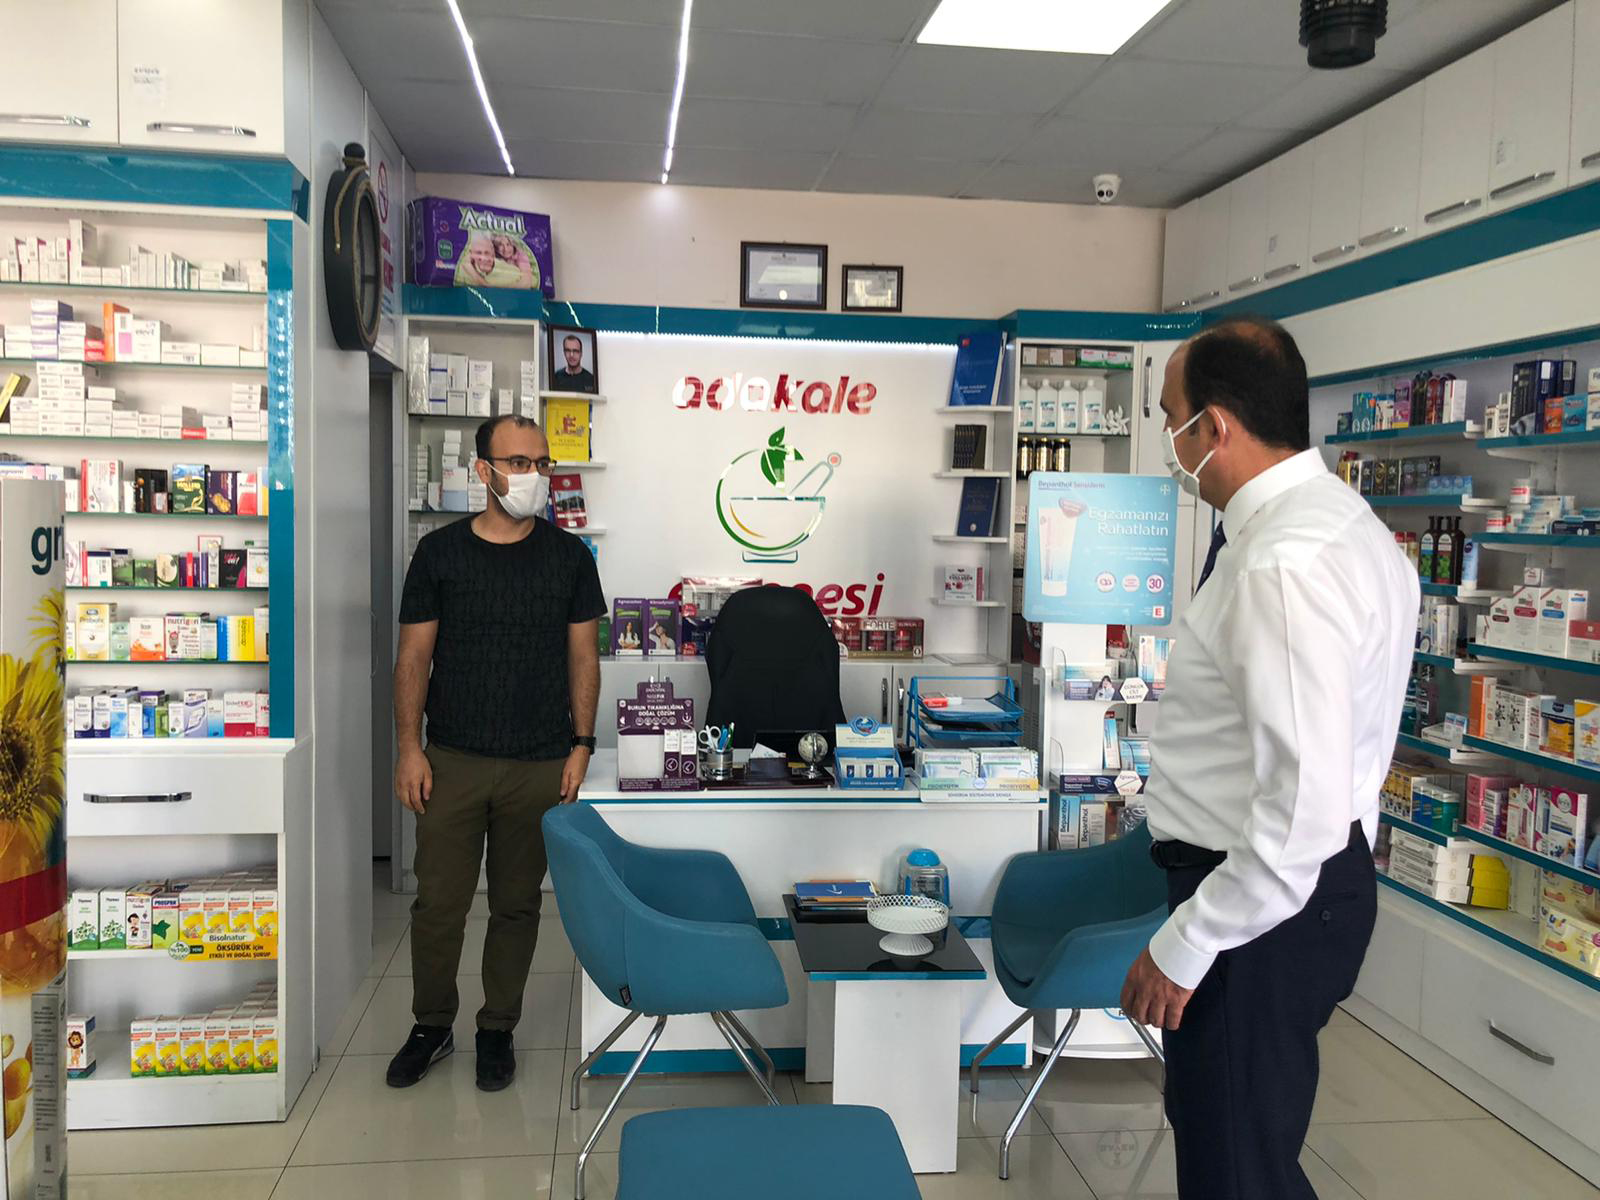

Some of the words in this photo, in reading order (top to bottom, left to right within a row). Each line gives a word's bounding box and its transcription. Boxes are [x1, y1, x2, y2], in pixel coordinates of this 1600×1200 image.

[463, 208, 525, 233] Actual
[672, 371, 877, 415] adakale
[1098, 522, 1169, 536] Rahatlatın
[1149, 578, 1162, 589] 30
[866, 620, 895, 630] FORTE
[1060, 798, 1068, 832] Bepanthol
[1081, 808, 1089, 842] Bepanthol
[209, 933, 246, 942] Bisolnatur
[216, 944, 251, 952] ÖKSÜRÜK
